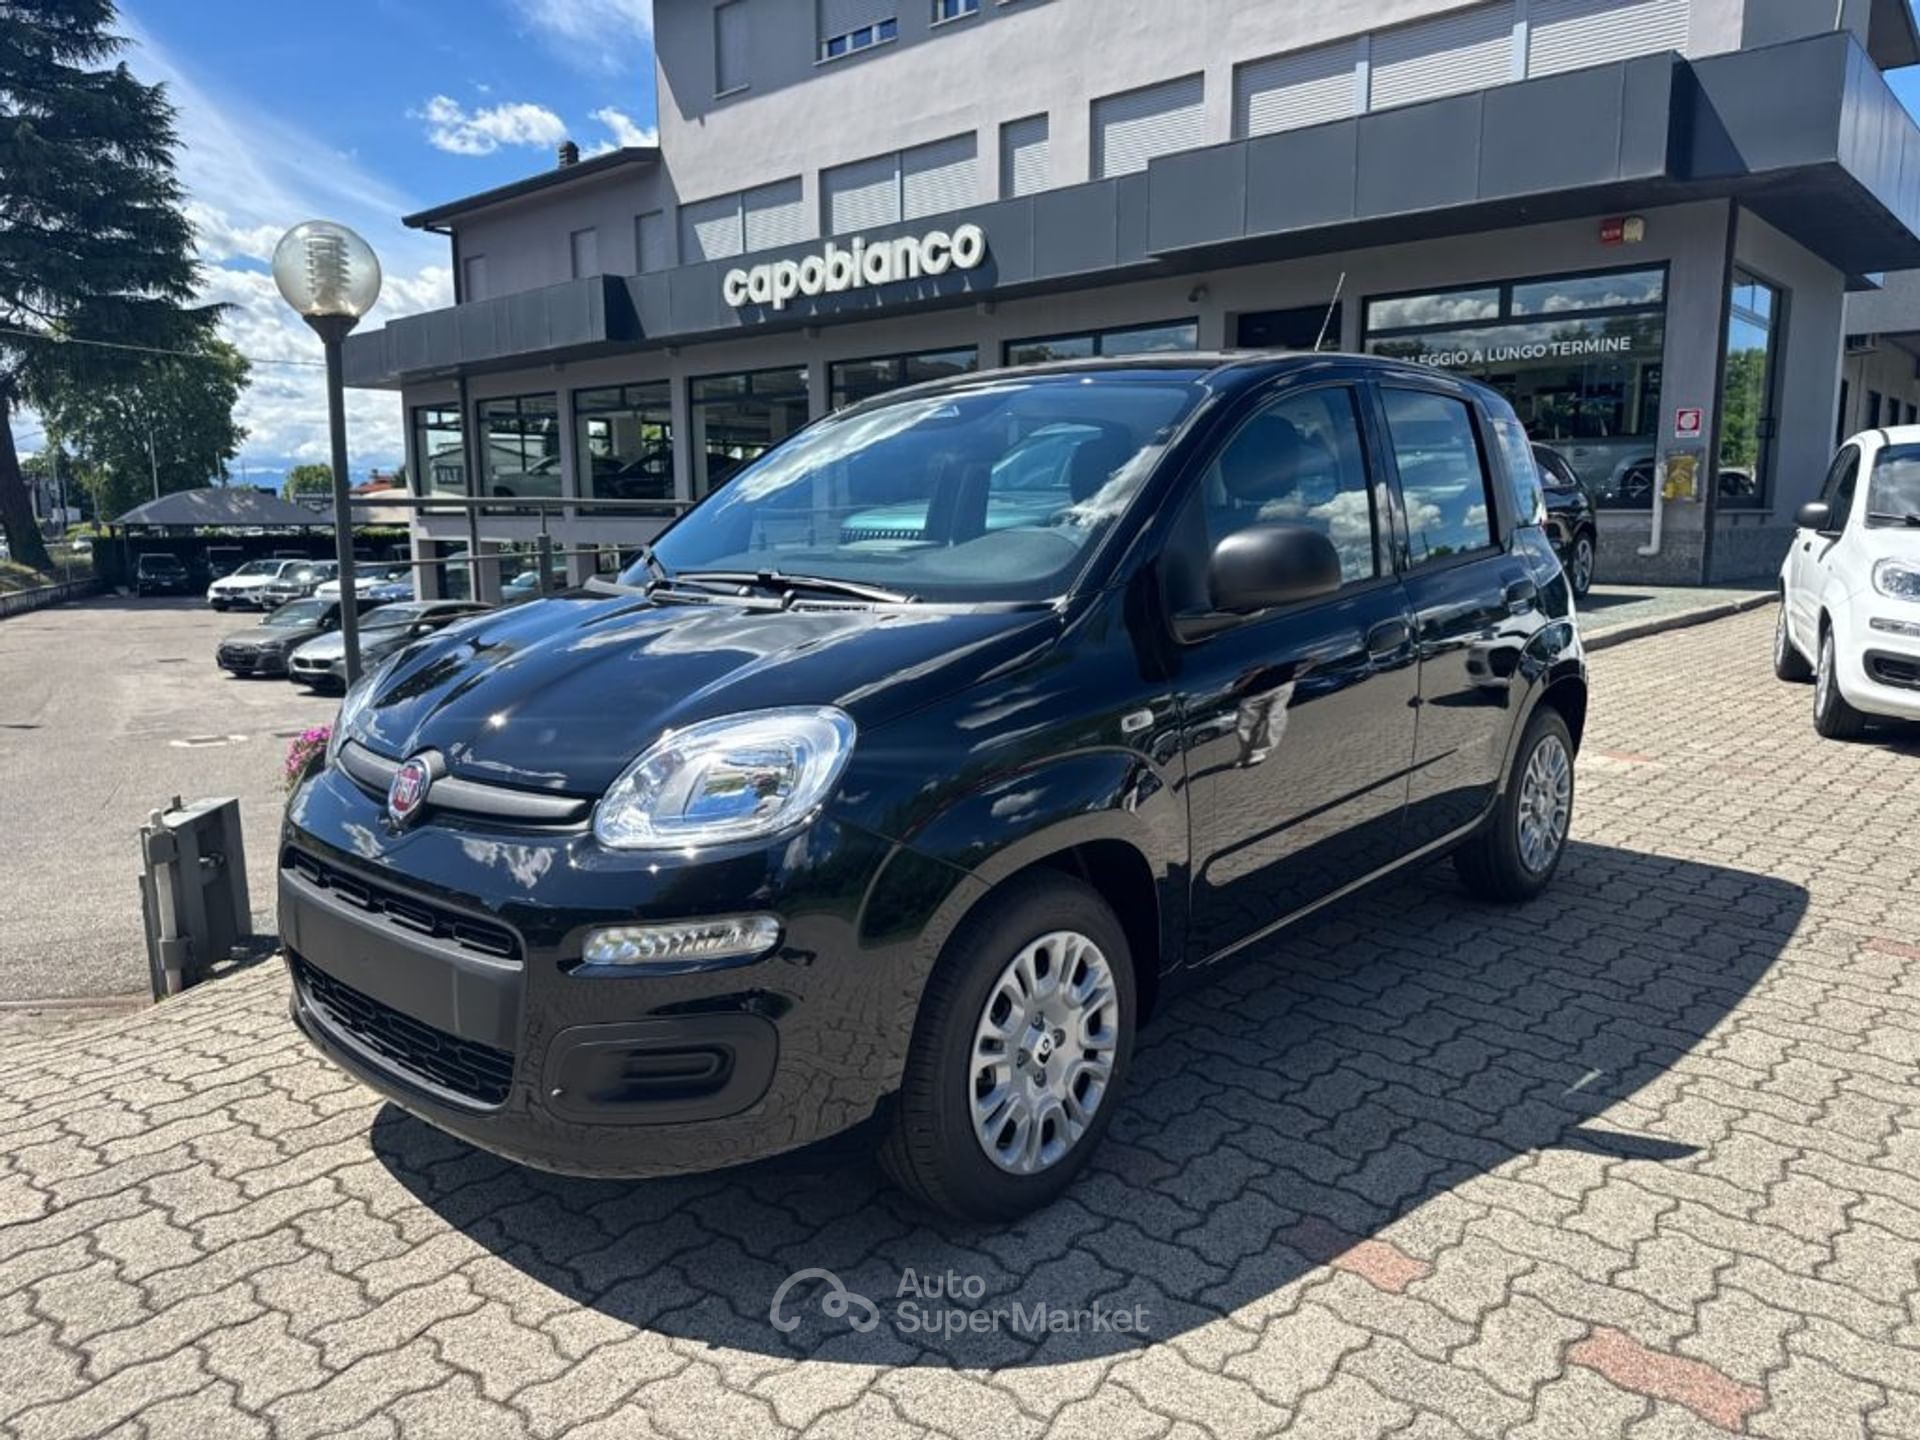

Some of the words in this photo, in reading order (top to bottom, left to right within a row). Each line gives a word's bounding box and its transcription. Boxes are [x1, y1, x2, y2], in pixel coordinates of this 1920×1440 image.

[723, 223, 986, 310] capobianco
[1471, 349, 1483, 363] A
[1487, 344, 1546, 361] LUNGO
[1549, 336, 1631, 356] TERMINE
